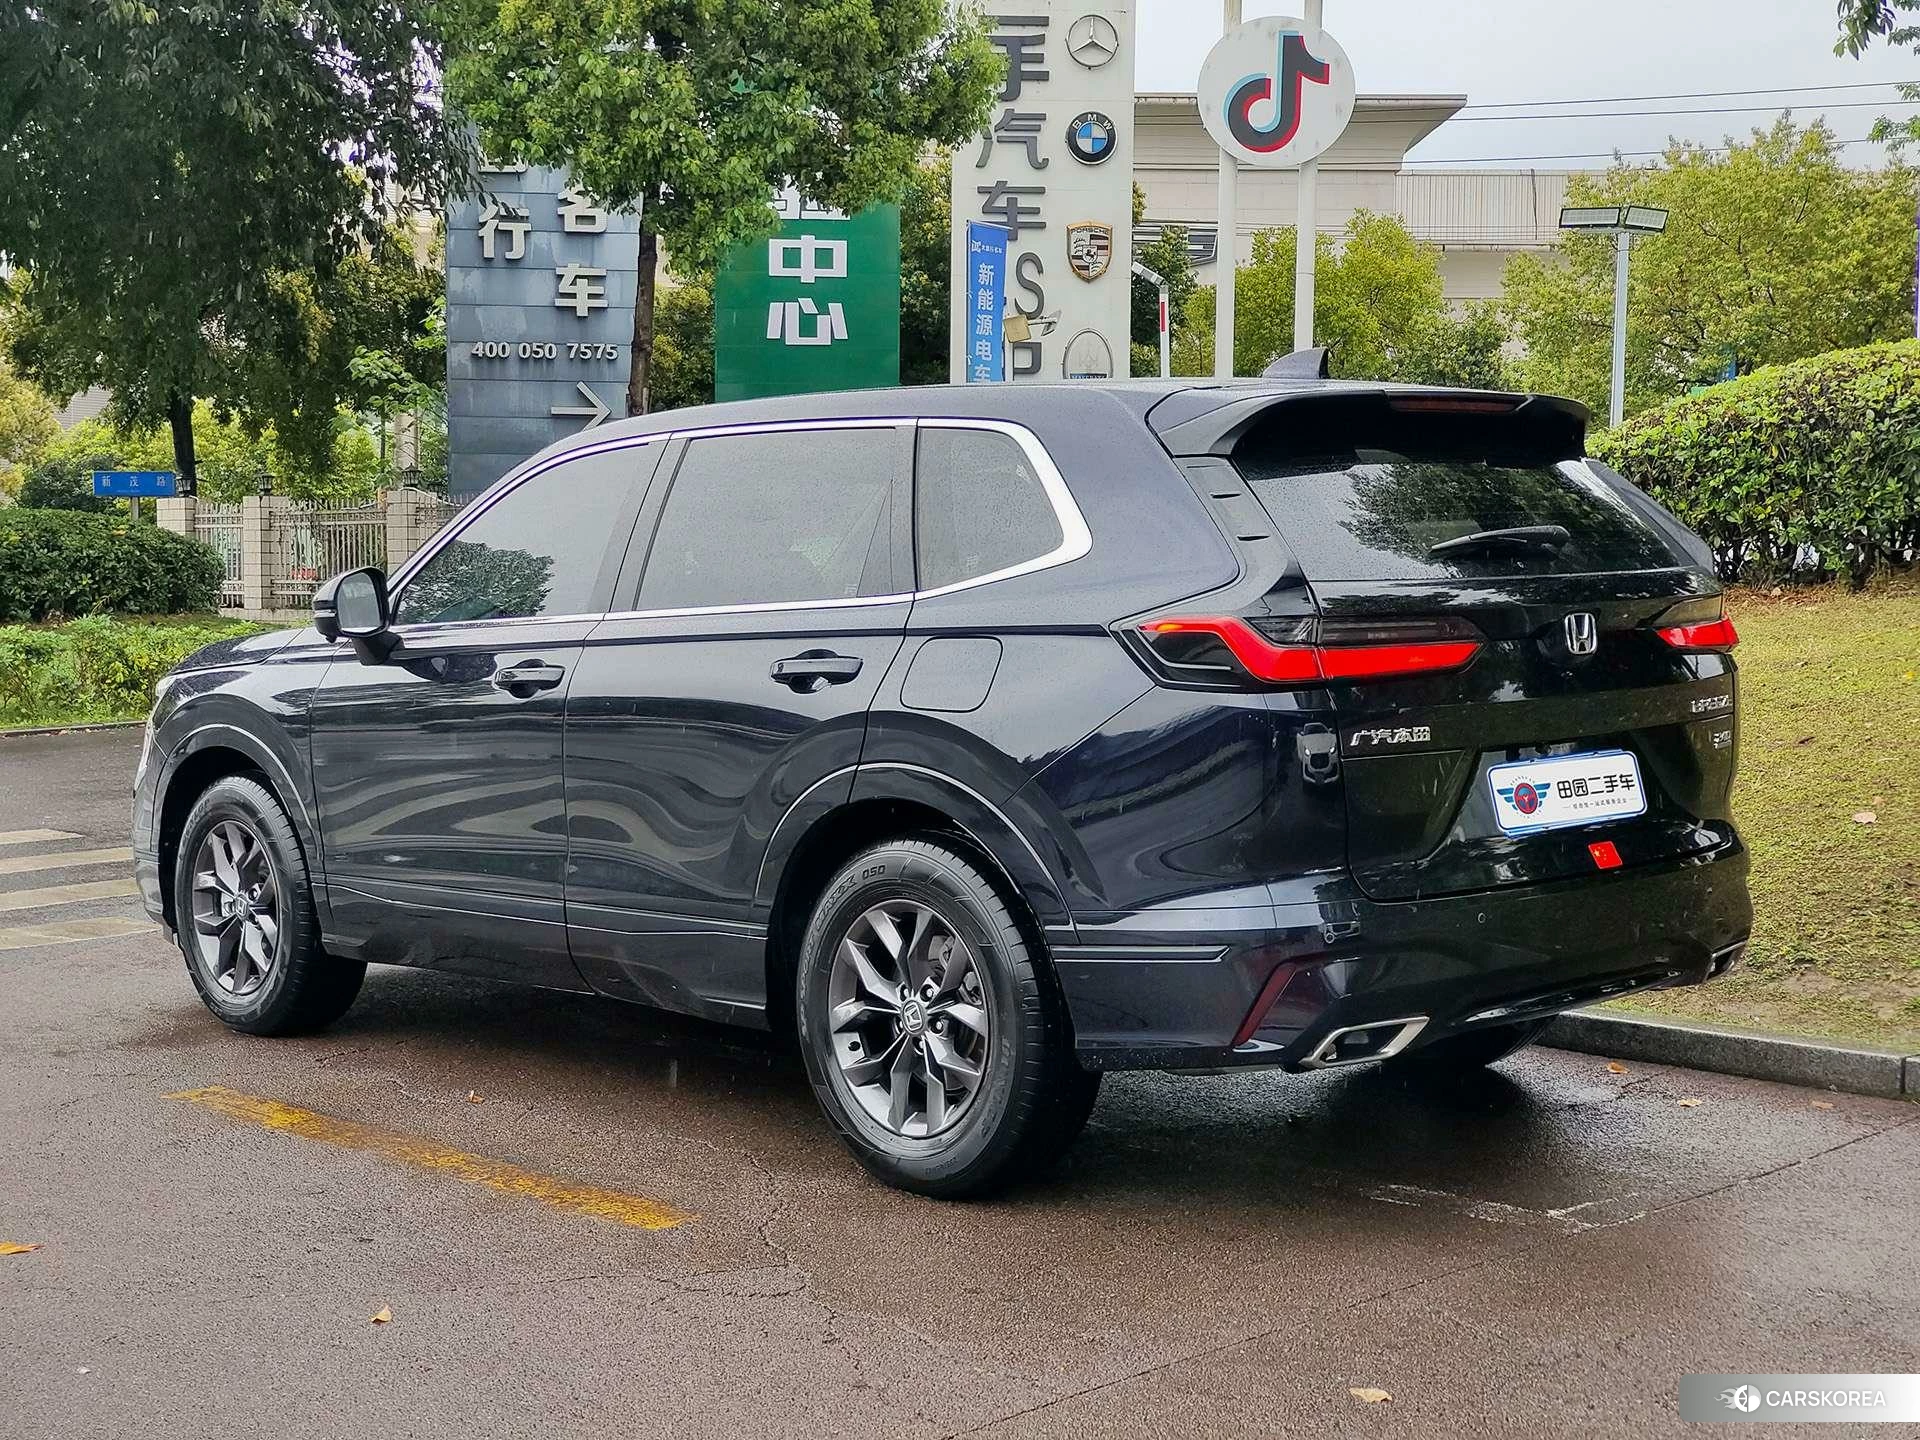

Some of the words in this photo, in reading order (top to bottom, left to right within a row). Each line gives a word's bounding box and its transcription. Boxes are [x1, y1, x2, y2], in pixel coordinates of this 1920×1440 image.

[1072, 114, 1112, 130] BMW
[471, 341, 511, 360] 400
[518, 342, 558, 360] 050
[566, 343, 619, 361] 7575
[1350, 726, 1431, 746] 广汽本田
[1556, 773, 1636, 799] 田园二手车
[860, 862, 886, 881] 050
